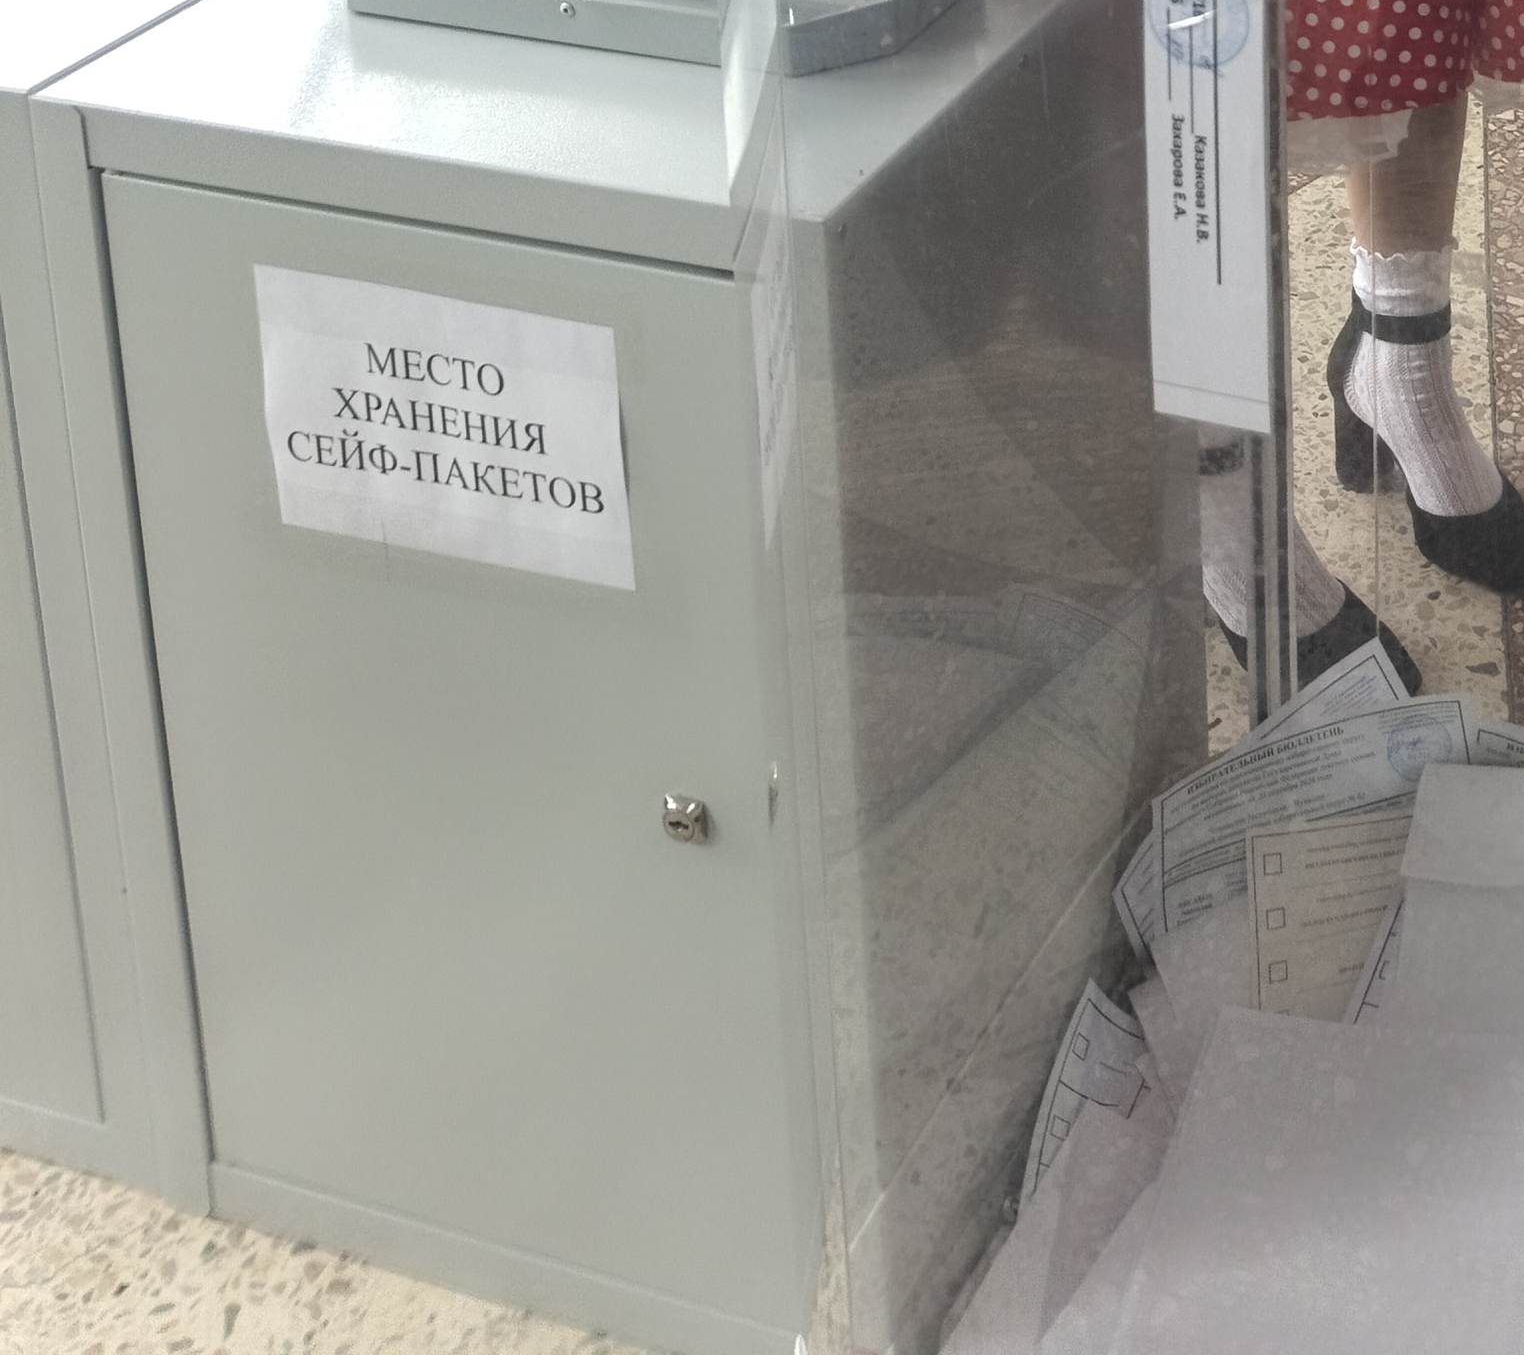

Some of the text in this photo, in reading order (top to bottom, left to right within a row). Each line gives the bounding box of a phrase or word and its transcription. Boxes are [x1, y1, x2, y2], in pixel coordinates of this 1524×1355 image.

[1171, 113, 1186, 186] Захарова
[1194, 134, 1209, 207] Казакова
[1174, 190, 1187, 220] Е.А.
[1196, 209, 1209, 244] Н.В.
[364, 341, 506, 397] МЕСТО
[332, 386, 547, 456] ХРАНЕНИЯ
[287, 428, 605, 515] СЕЙФ-ПАКЕТОВ
